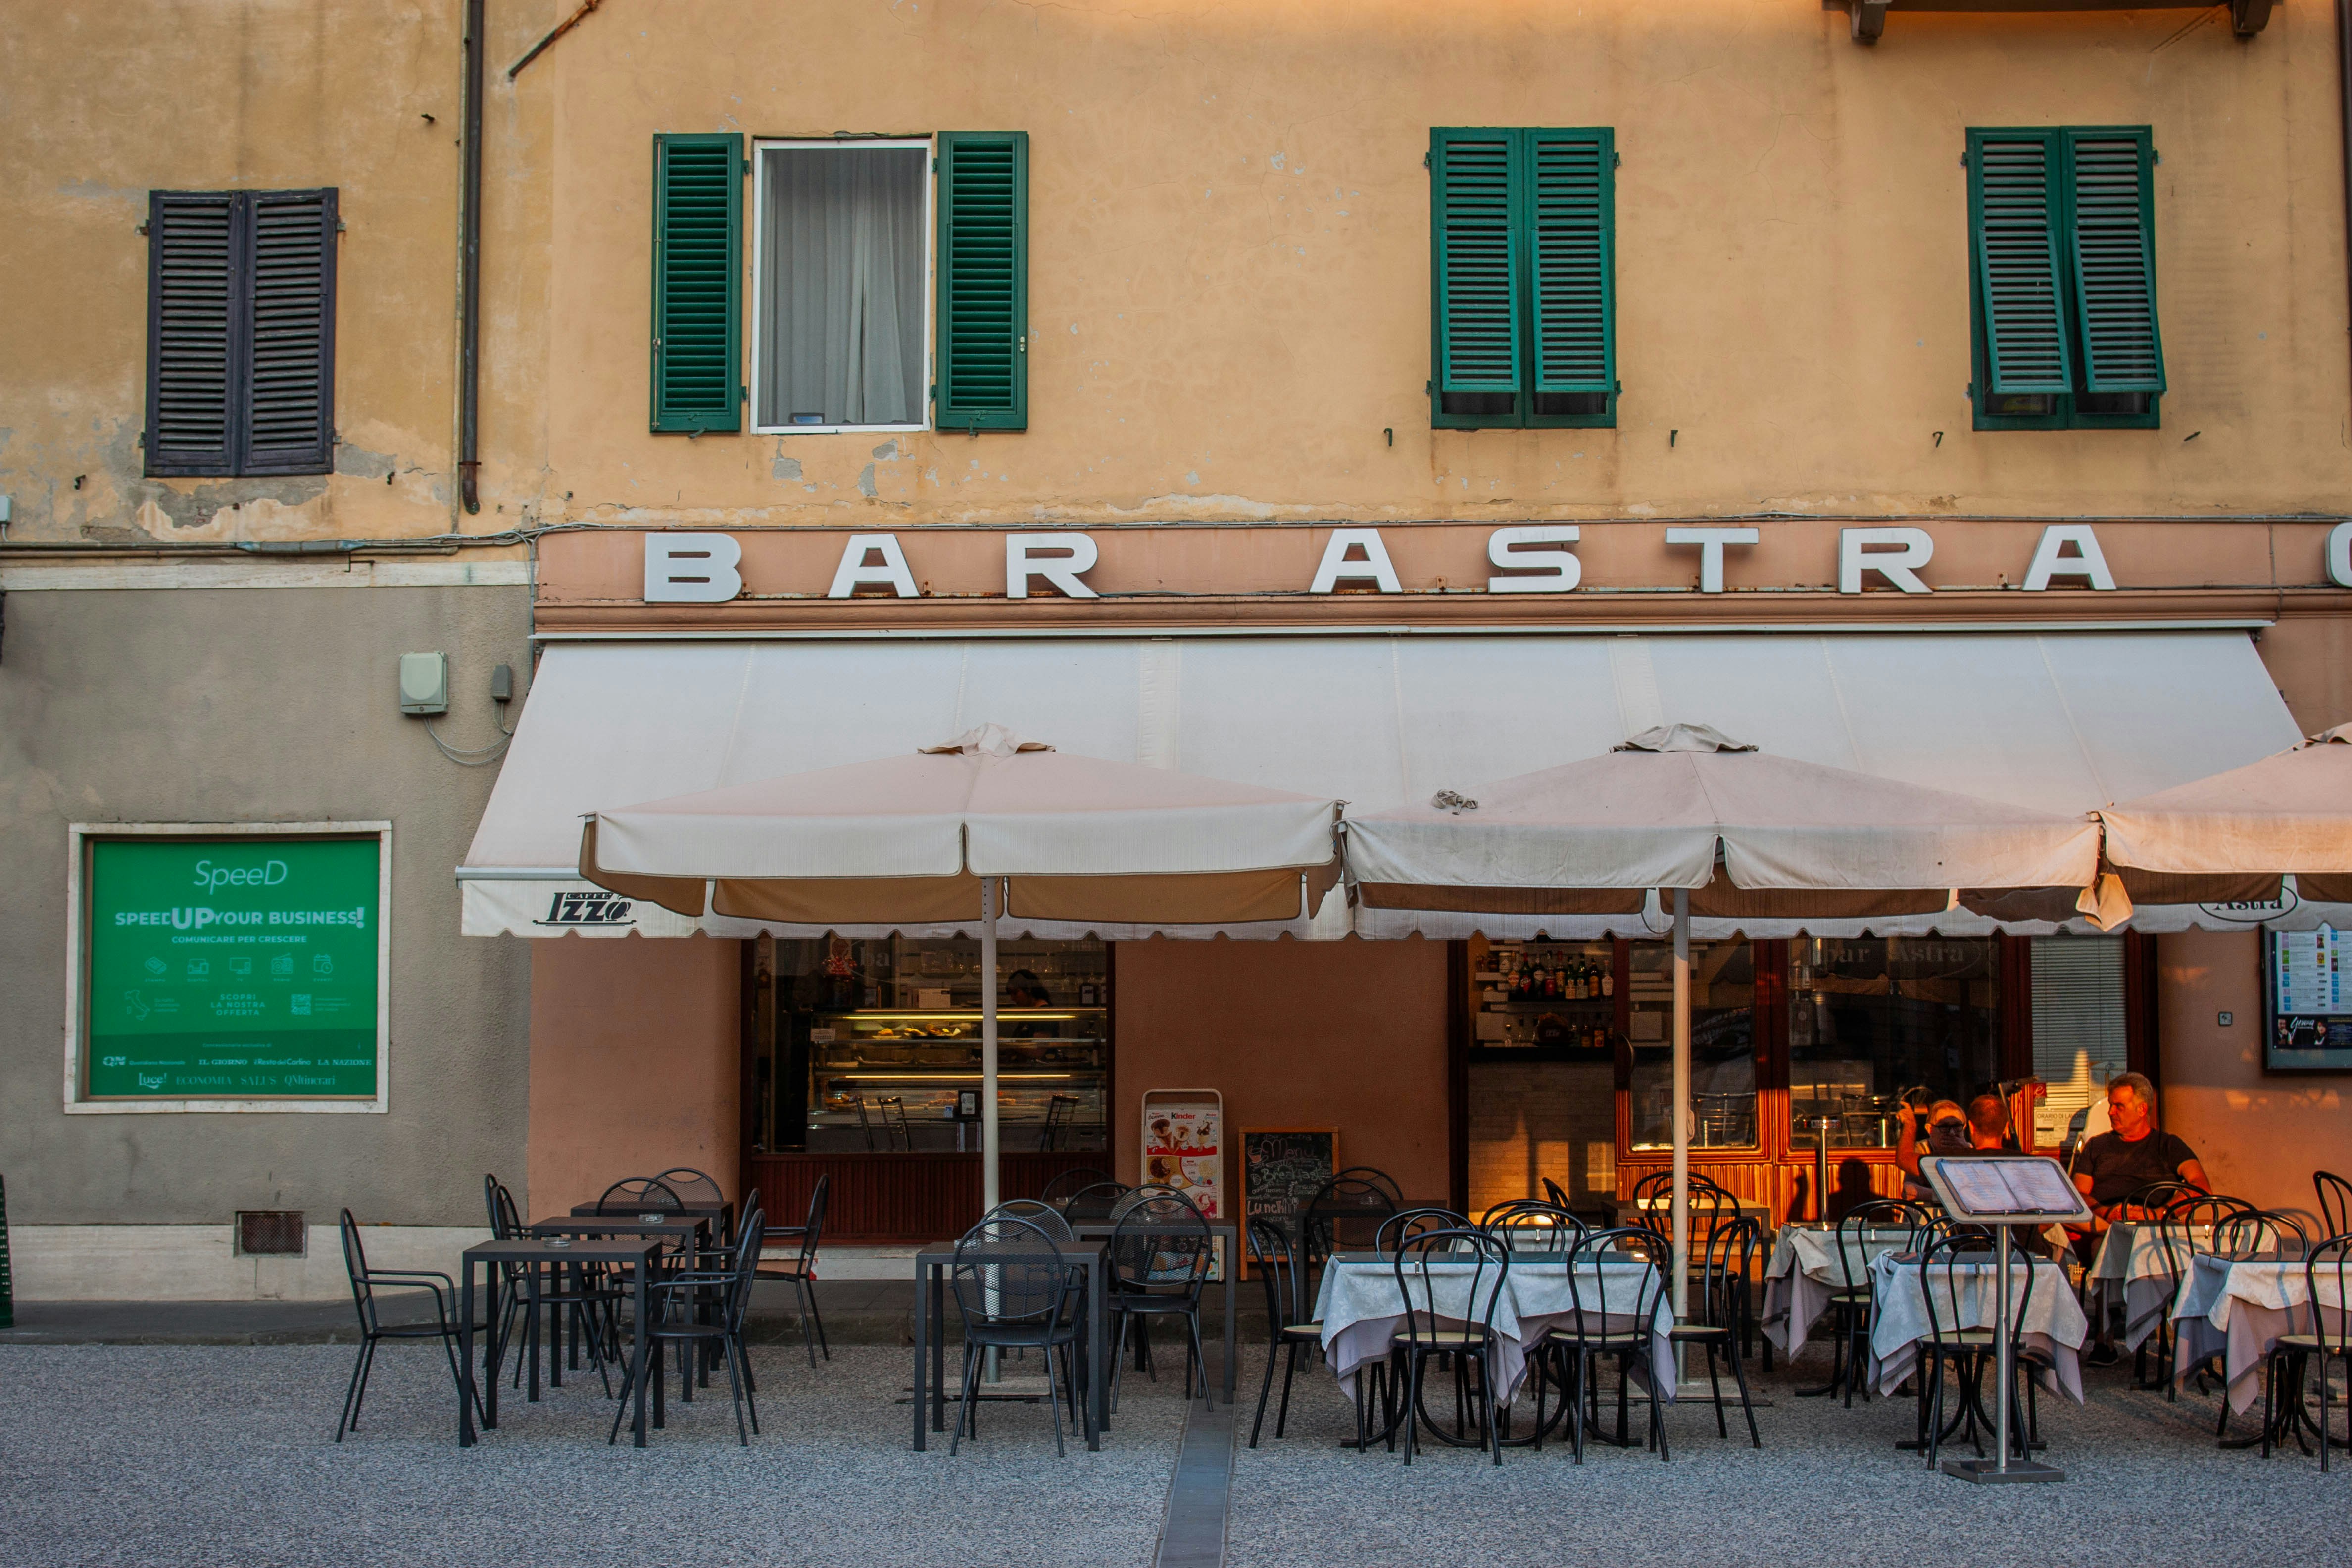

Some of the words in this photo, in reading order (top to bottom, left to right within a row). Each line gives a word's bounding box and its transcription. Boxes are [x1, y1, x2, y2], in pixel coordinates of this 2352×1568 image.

[644, 531, 1099, 603] BAR
[1309, 524, 2117, 595] ASTRA
[193, 860, 288, 895] SpeeD
[115, 912, 171, 925] SPEED
[172, 907, 214, 929] UP
[214, 912, 263, 925] YOUR
[269, 907, 365, 929] BUSINESS!
[139, 1073, 167, 1089] Luce!
[176, 1076, 232, 1085] ECONOMIA
